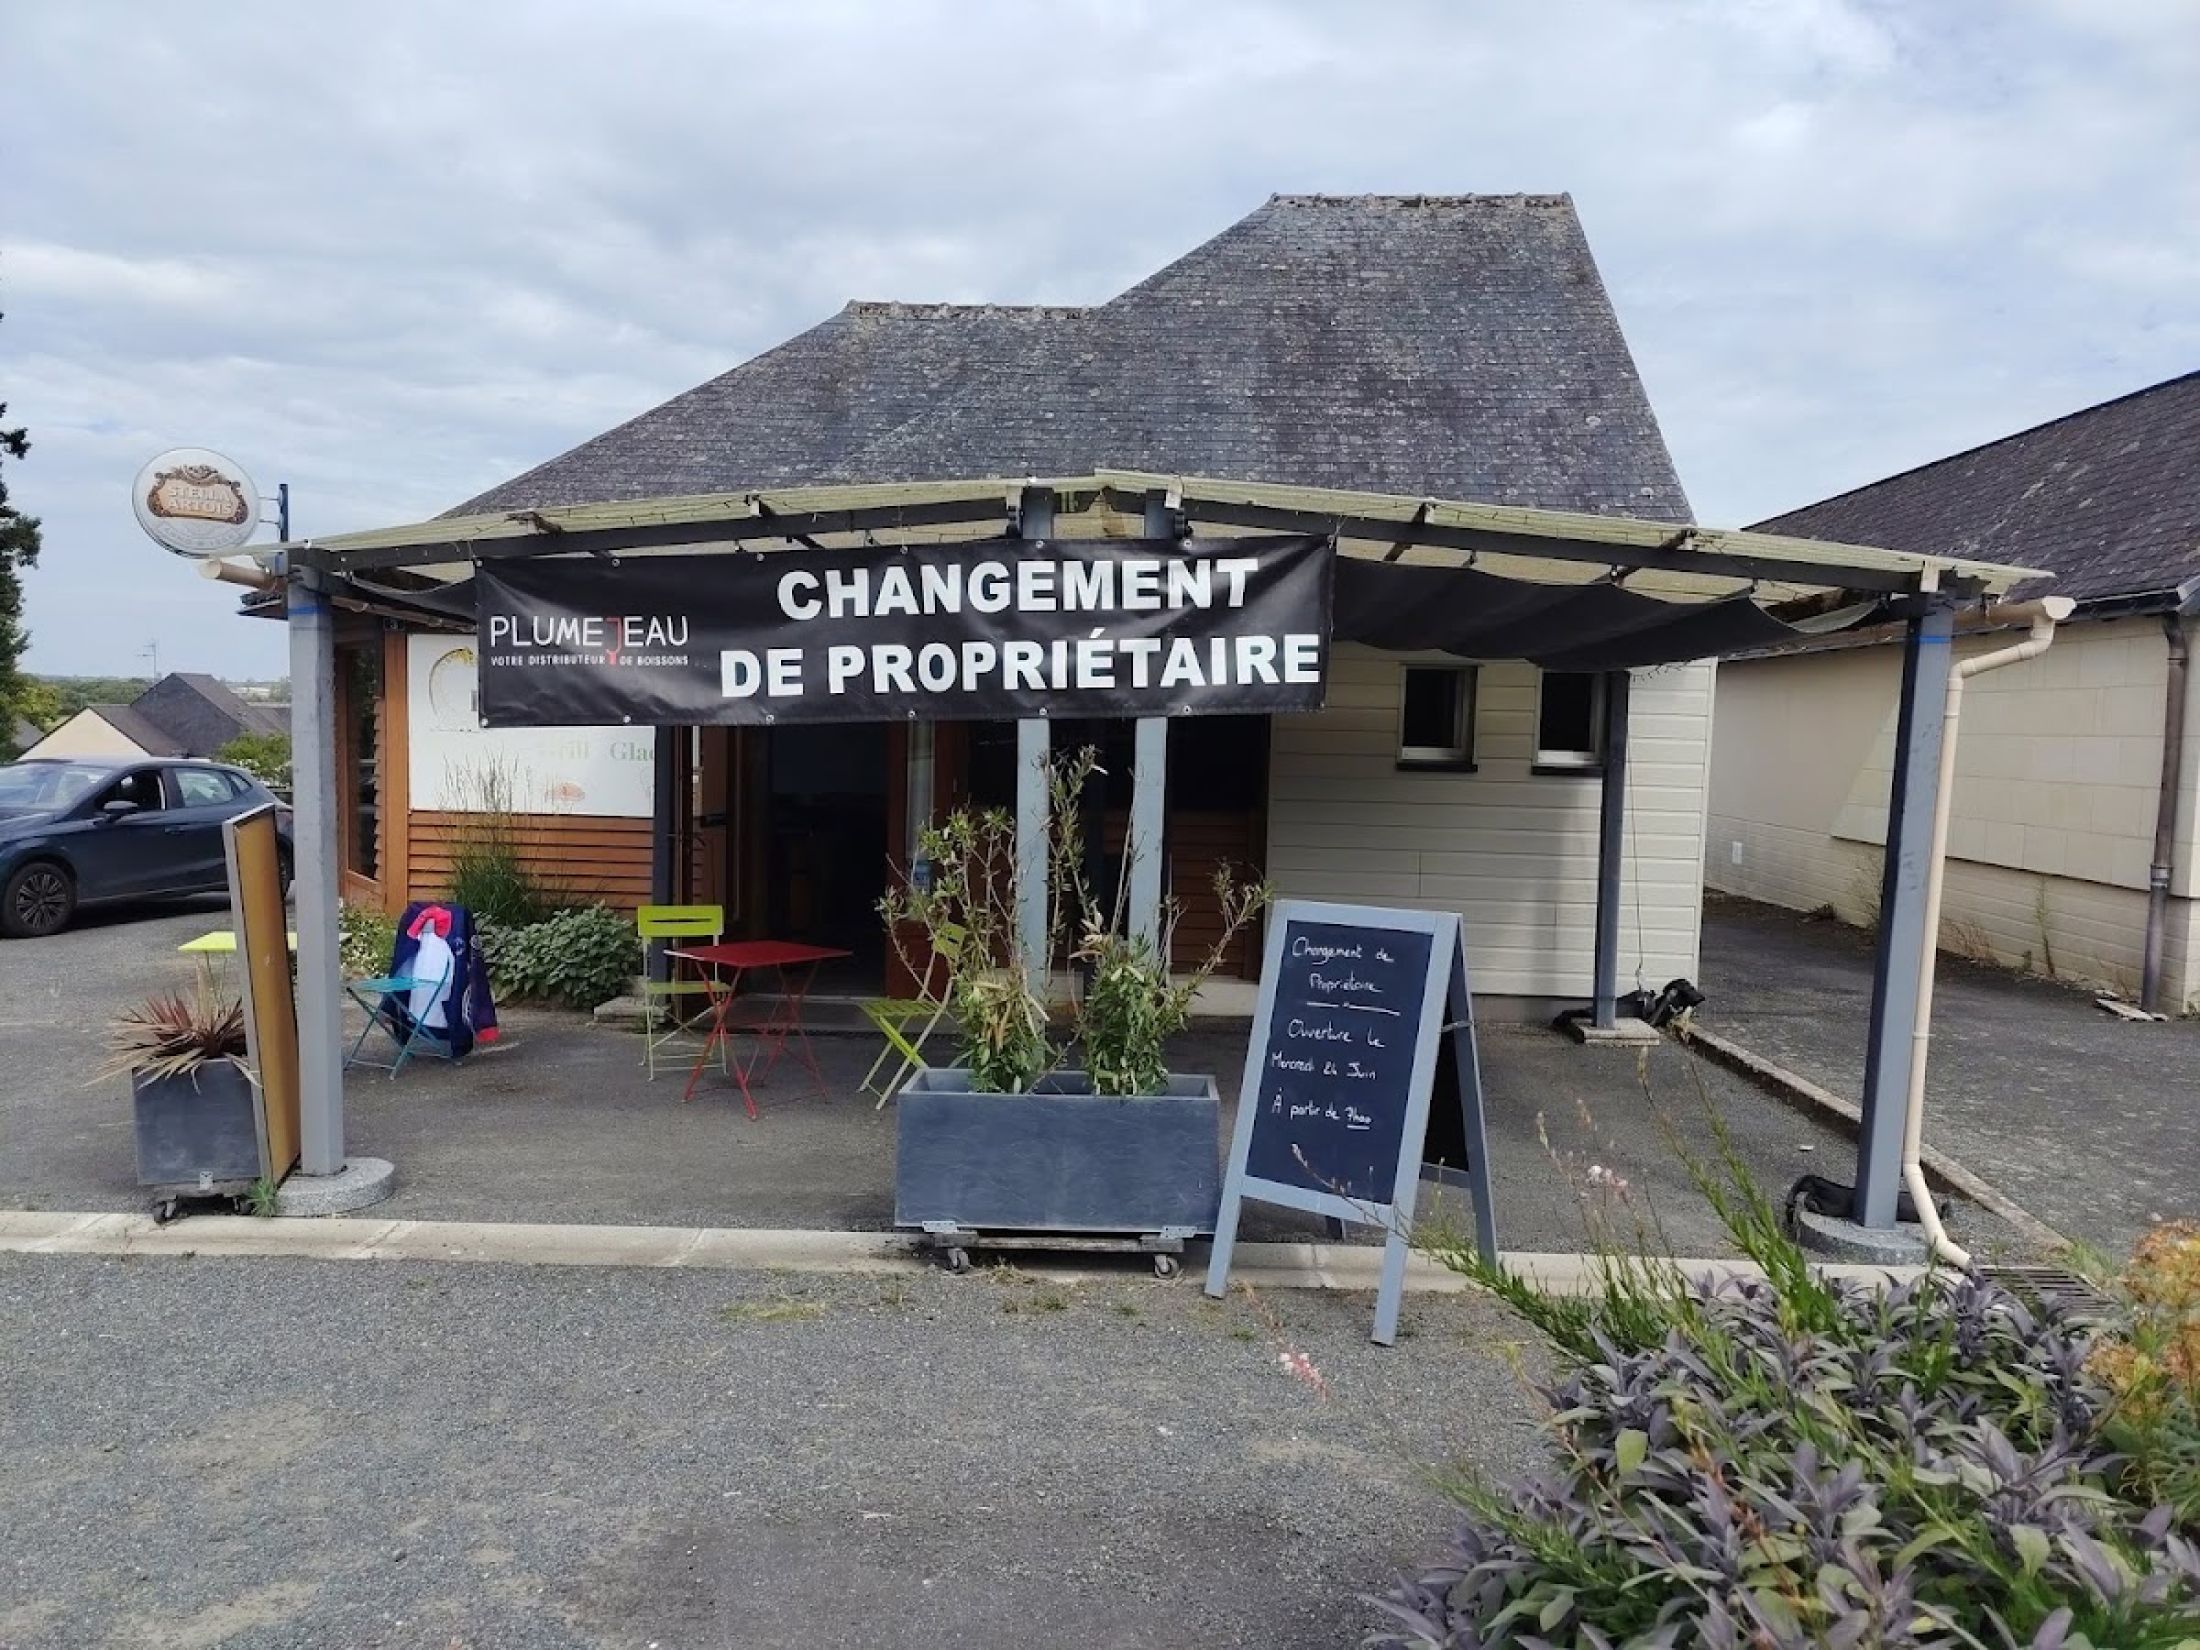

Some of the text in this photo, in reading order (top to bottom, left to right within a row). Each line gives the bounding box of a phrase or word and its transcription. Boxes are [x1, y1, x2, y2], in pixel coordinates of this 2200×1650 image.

[779, 559, 1258, 620] CHANGEMENT
[490, 654, 690, 667] VOTRE DISTRIBUTEUR DE BOISSONS
[721, 627, 1319, 697] DE PROPRIÉTAIRE
[1376, 949, 1394, 962] de
[1288, 1019, 1352, 1041] Ouverture
[1346, 1062, 1377, 1081] Juin
[1290, 1099, 1321, 1120] partir
[1325, 1101, 1341, 1120] de
